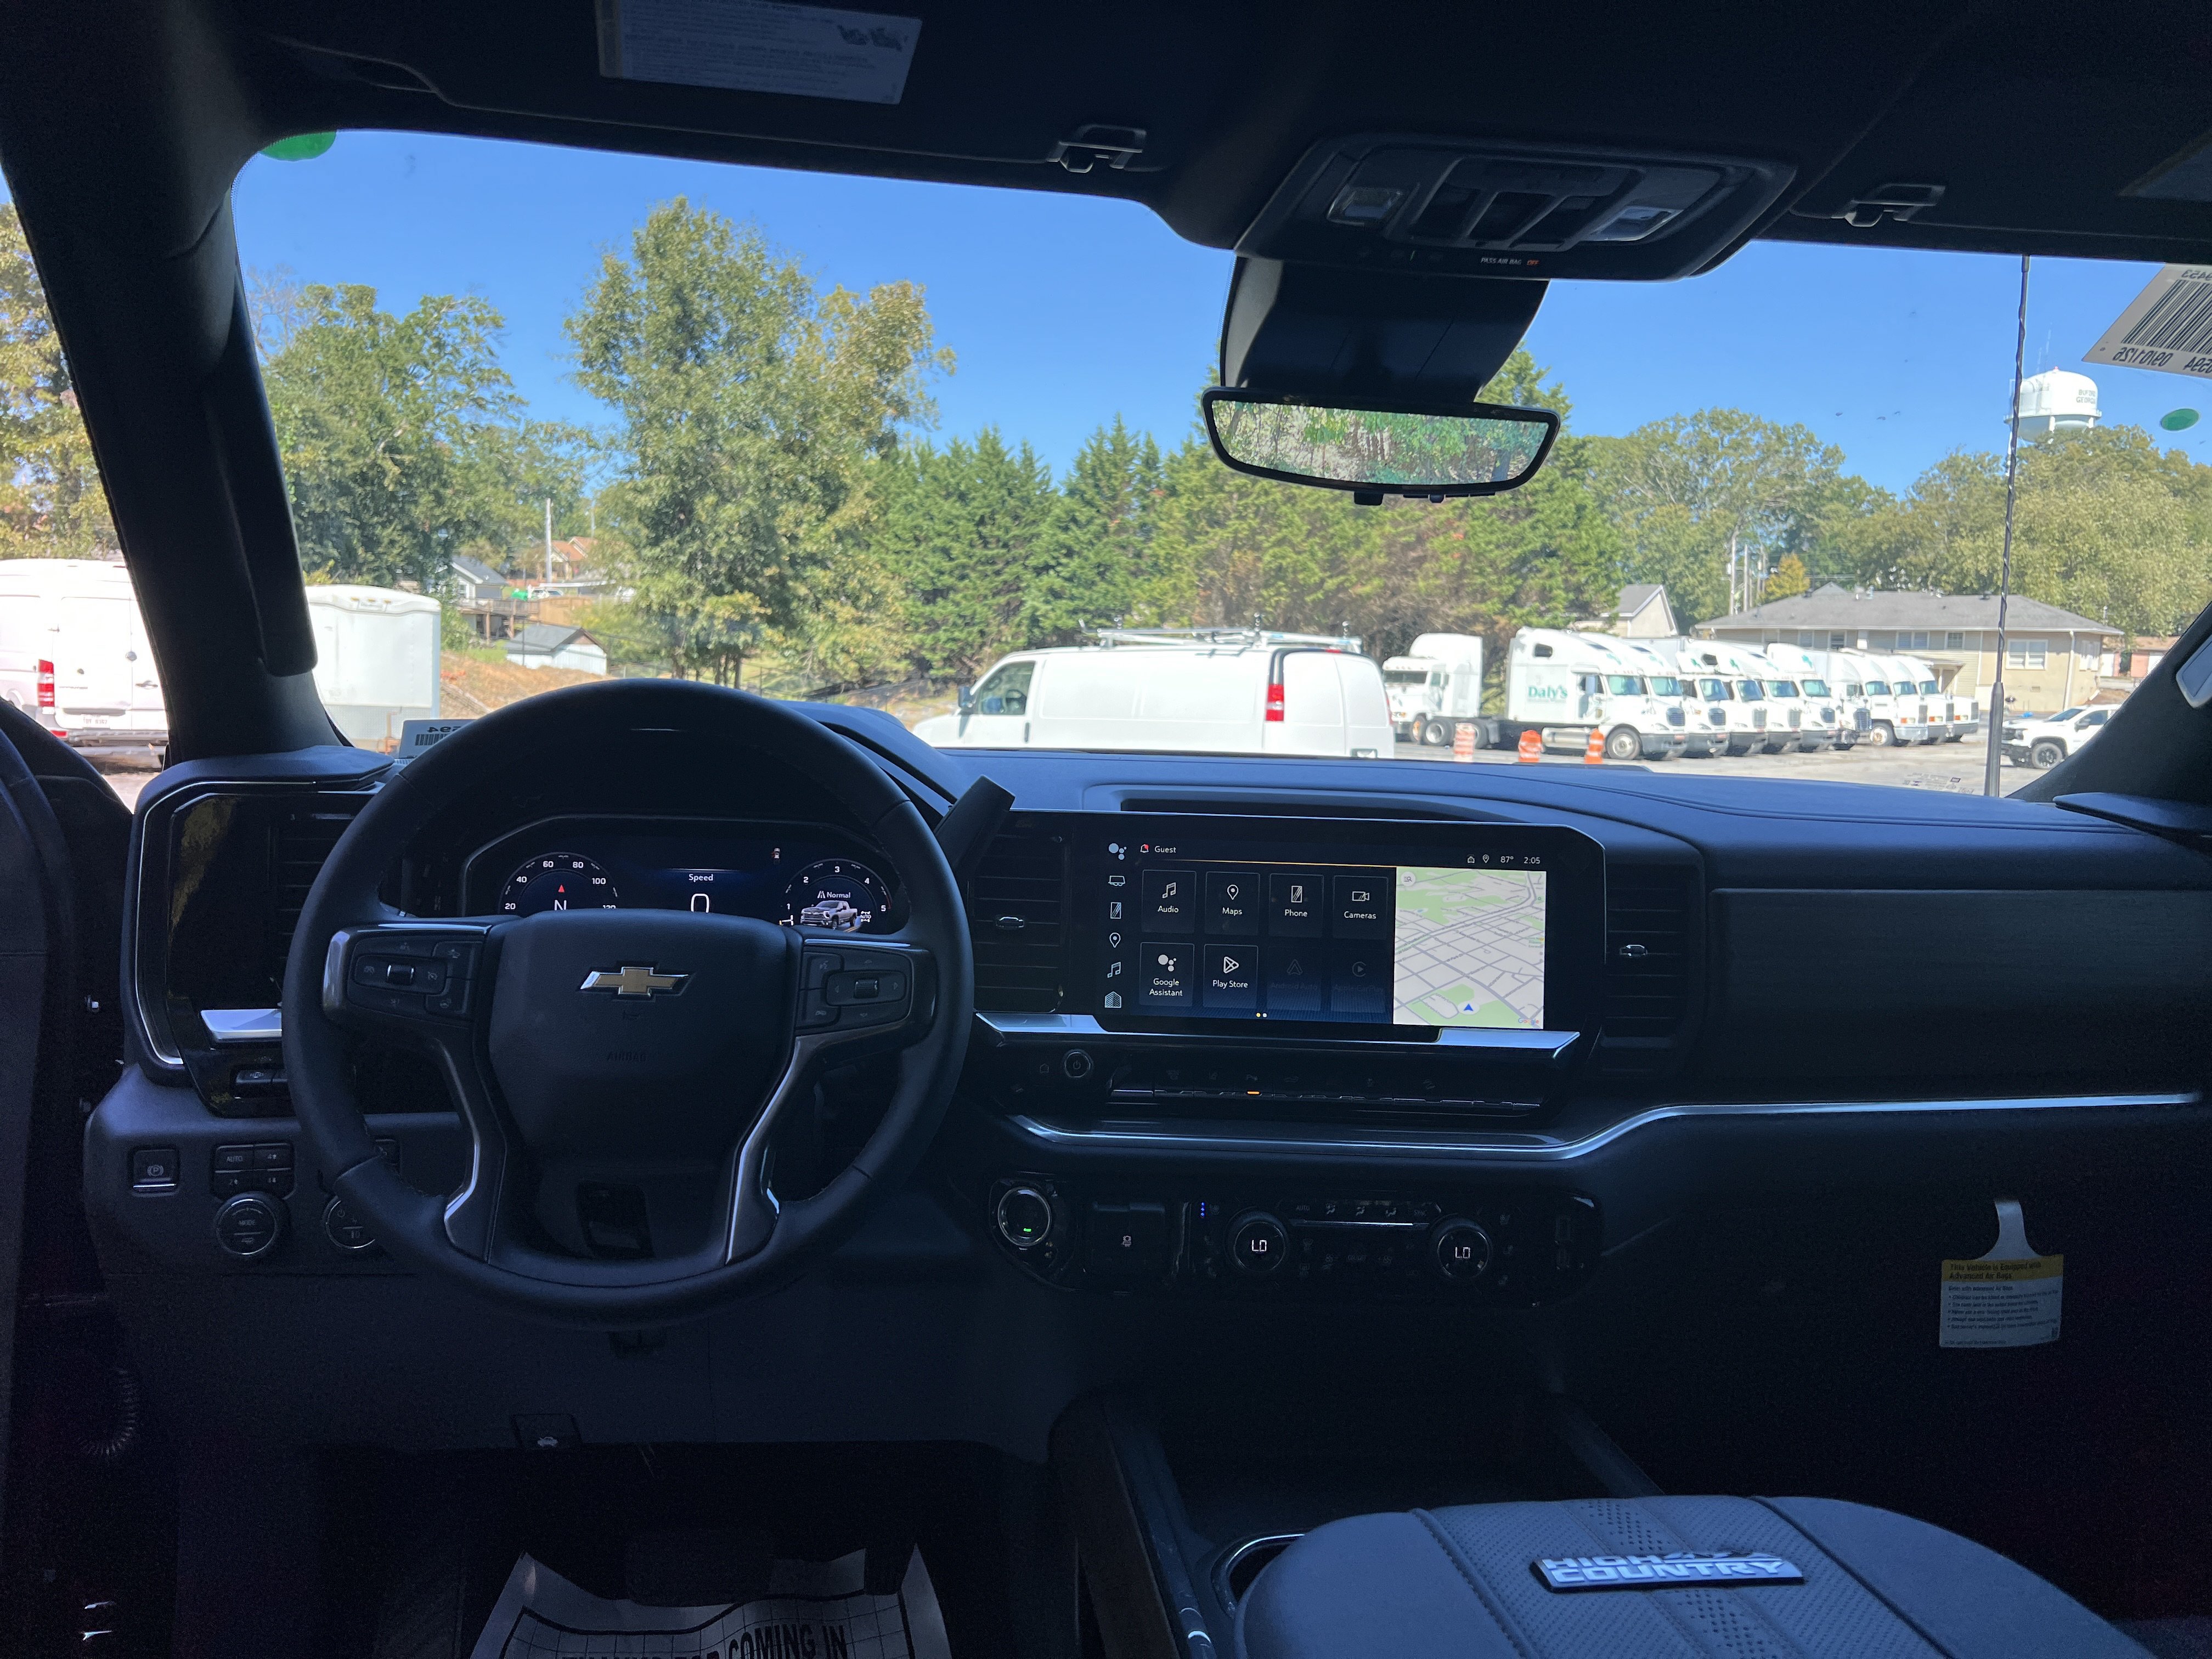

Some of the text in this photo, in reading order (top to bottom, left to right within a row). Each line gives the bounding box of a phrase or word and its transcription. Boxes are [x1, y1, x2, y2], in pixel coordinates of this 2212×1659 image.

[1528, 685, 1567, 702] Daly's
[688, 873, 714, 883] Speed
[554, 899, 567, 911] N
[690, 893, 710, 912] 0
[1222, 907, 1243, 916] Maps
[1284, 909, 1308, 917] Phone
[1344, 911, 1376, 919] Cameras
[1153, 978, 1180, 987] Google
[1212, 979, 1249, 989] Play Store
[1149, 988, 1183, 997] Assistant
[1517, 1018, 1539, 1026] Google
[1251, 1239, 1267, 1252] LO
[1454, 1246, 1471, 1259] LO
[1542, 1554, 1662, 1570] HIGH
[1551, 1560, 1786, 1583] COUNTRY
[820, 1625, 849, 1656] IN
